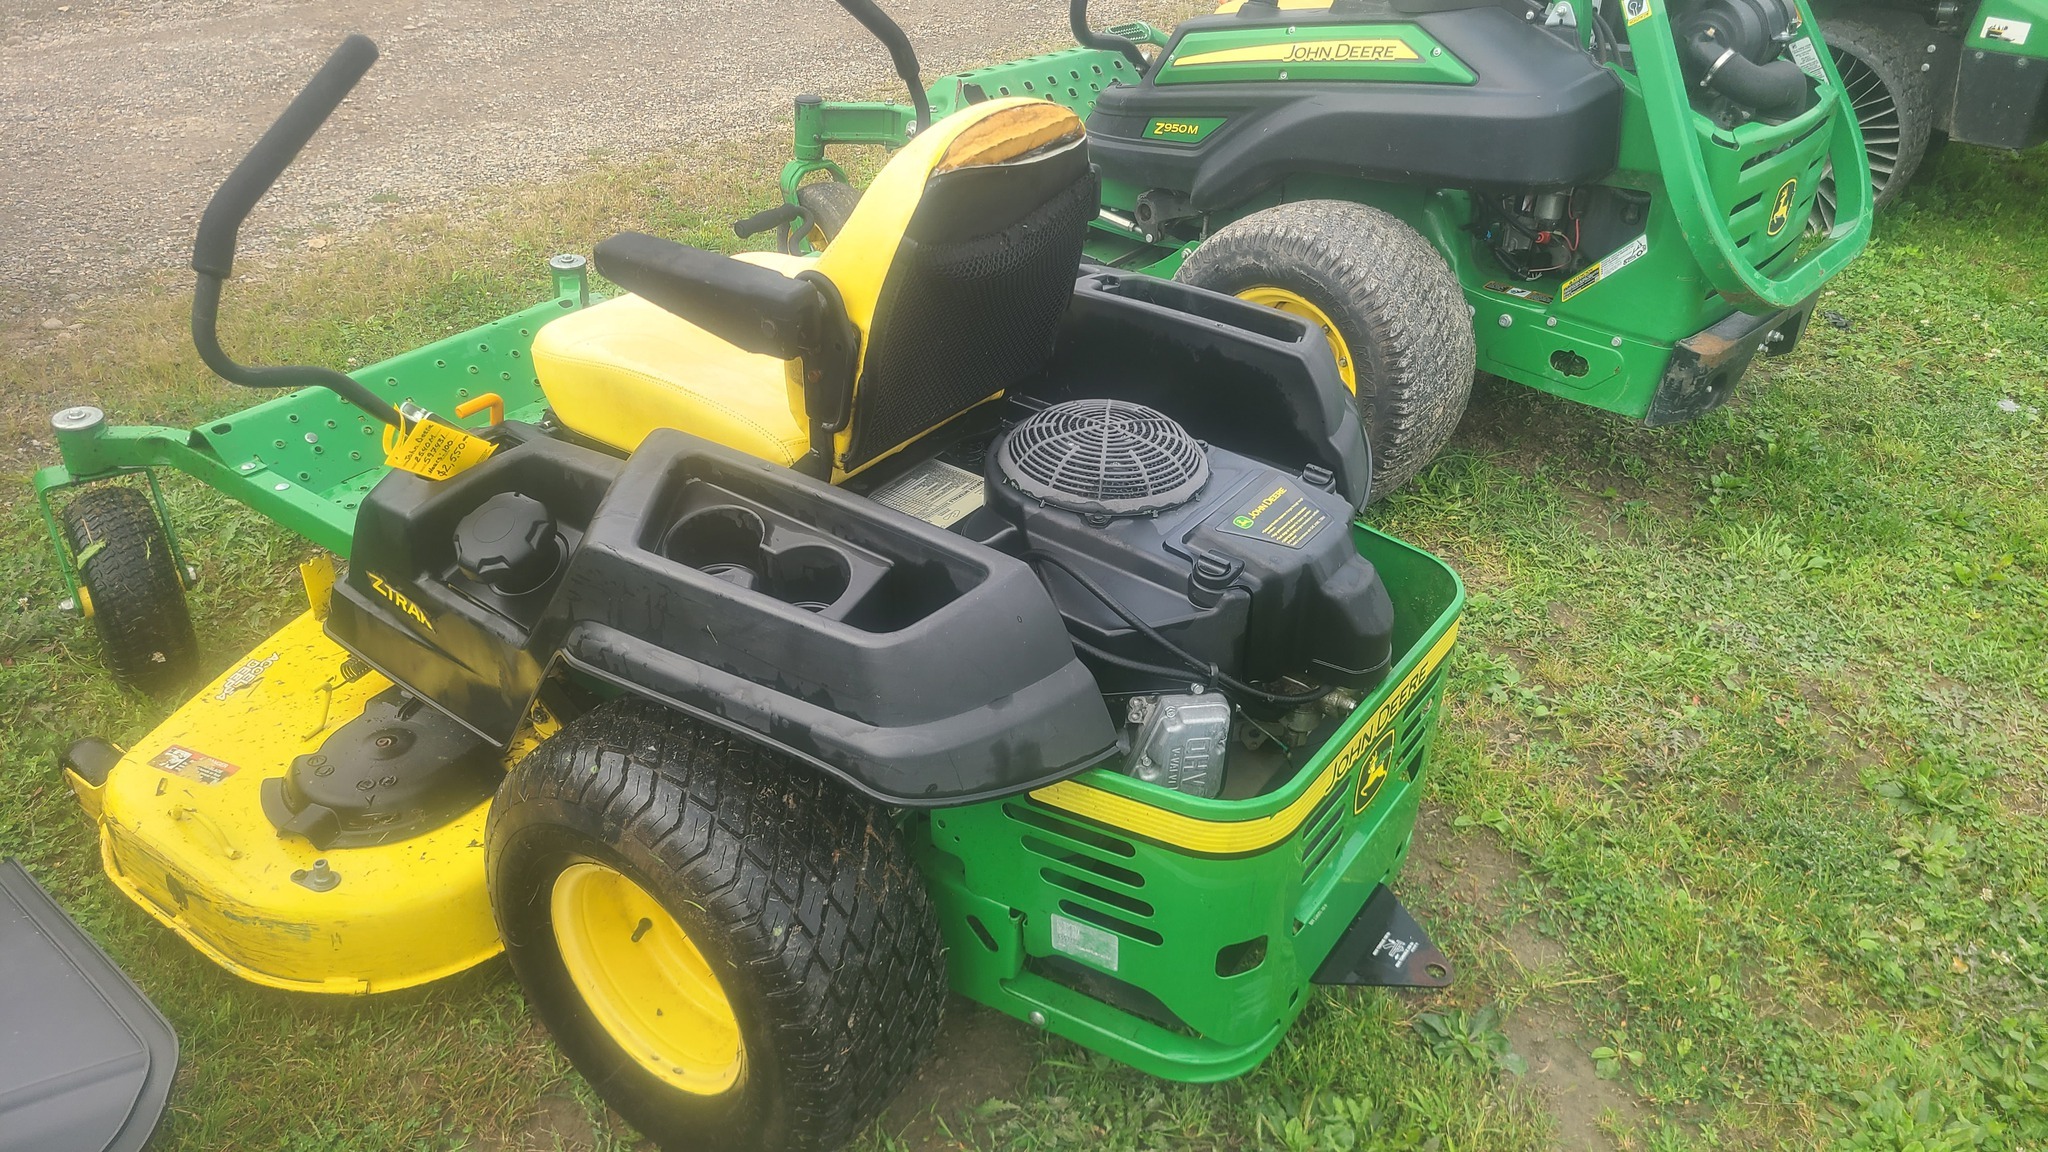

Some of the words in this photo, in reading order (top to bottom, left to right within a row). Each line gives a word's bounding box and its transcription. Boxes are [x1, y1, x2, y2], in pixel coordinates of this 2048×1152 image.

[1284, 44, 1332, 60] JOHN
[1334, 43, 1397, 58] DEERE
[1154, 121, 1199, 135] Z950M
[1248, 502, 1269, 520] JOHN
[1263, 486, 1287, 506] DEERE
[225, 659, 260, 688] DEEP
[1324, 723, 1375, 796] JOHN
[1376, 661, 1429, 733] DEERE
